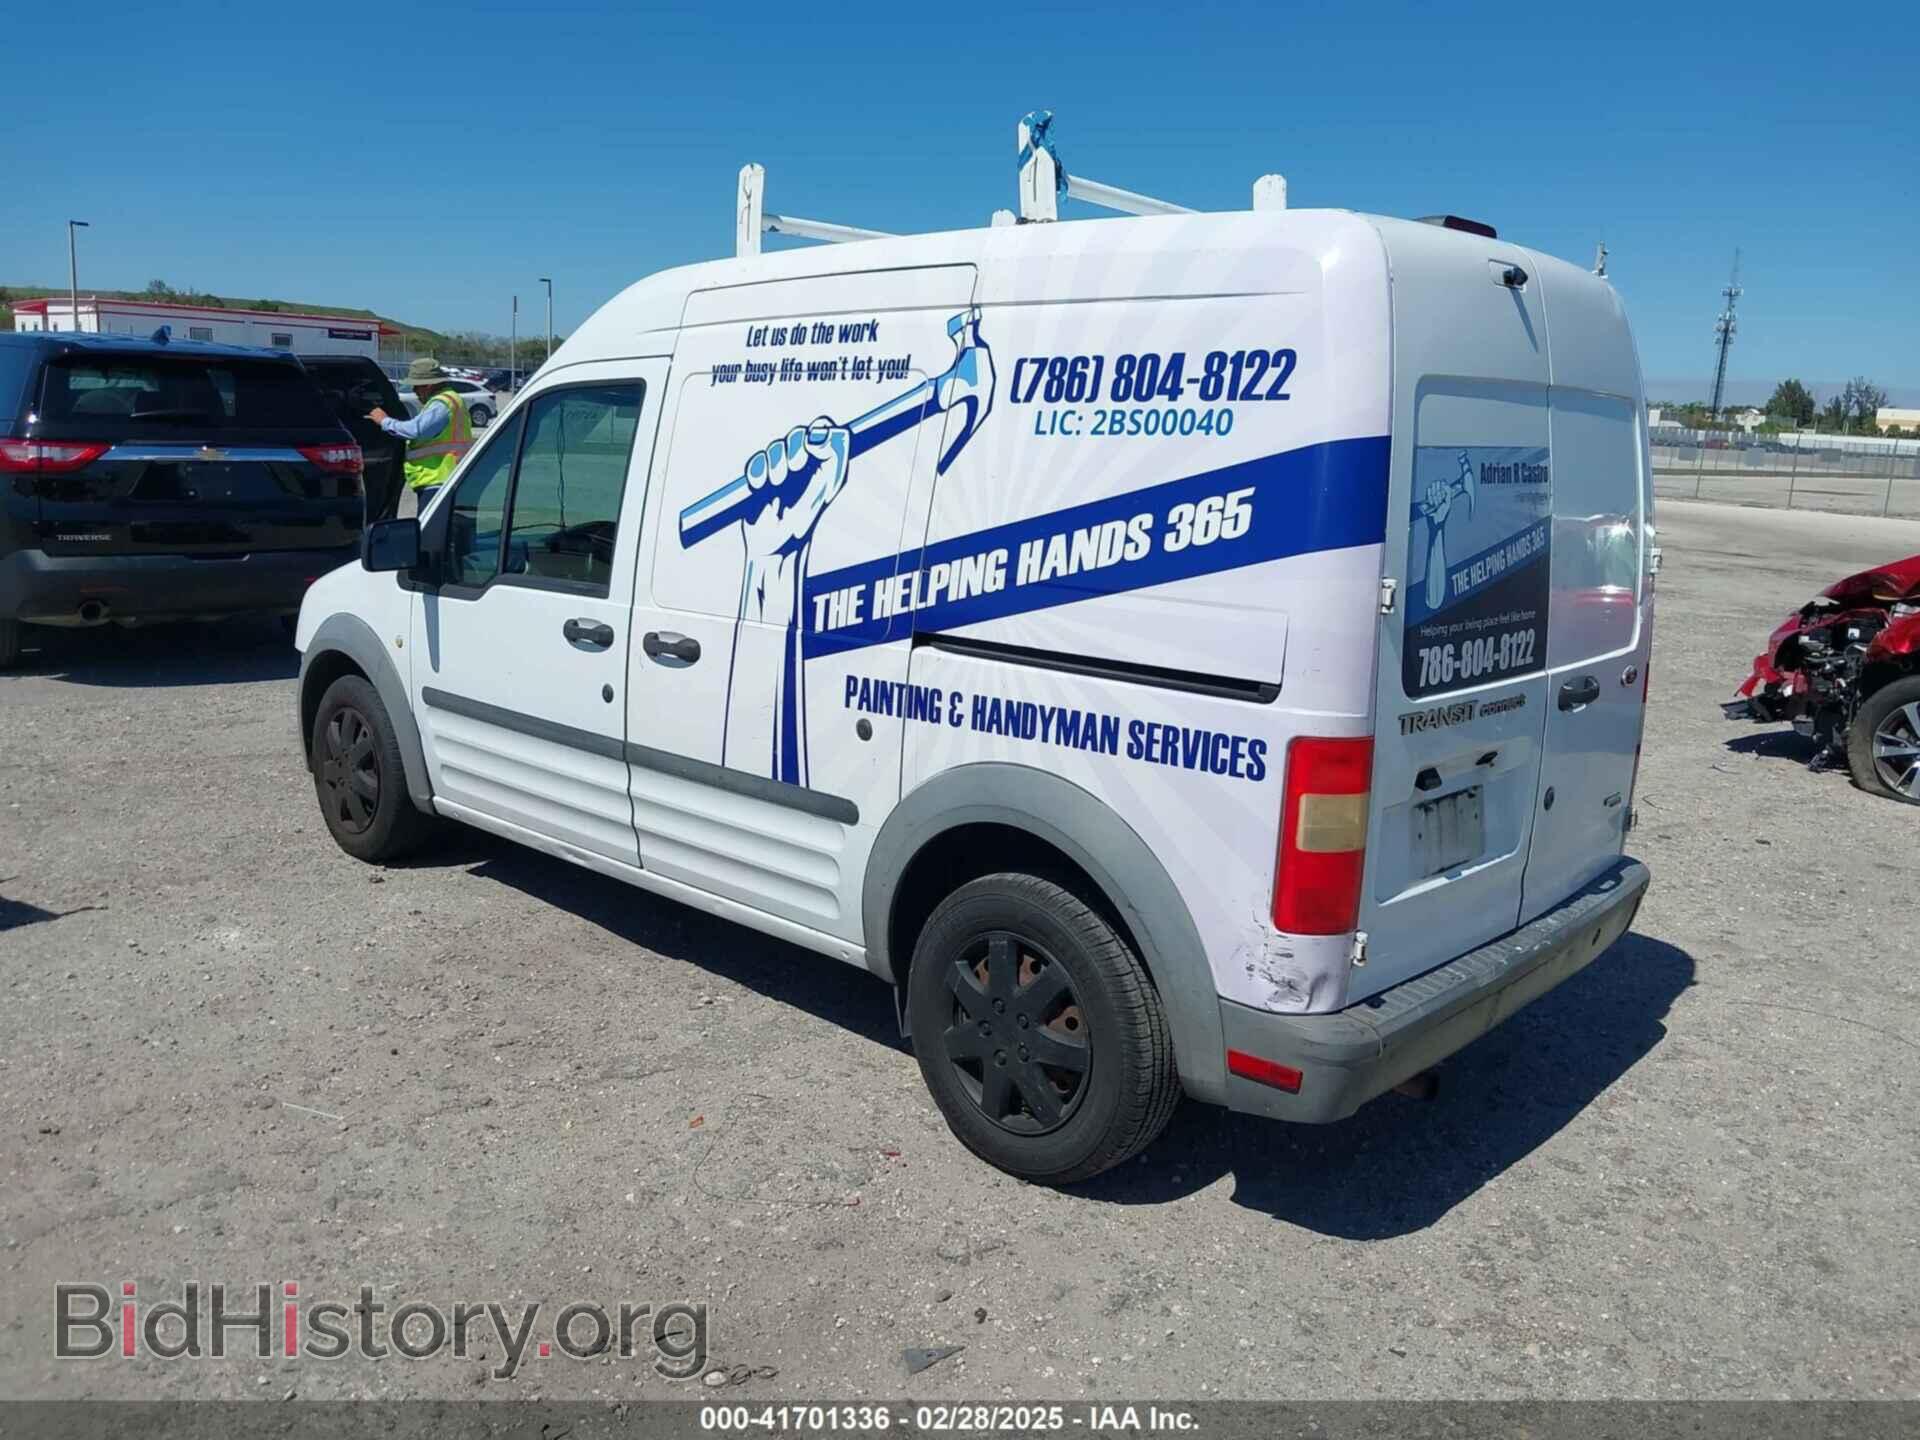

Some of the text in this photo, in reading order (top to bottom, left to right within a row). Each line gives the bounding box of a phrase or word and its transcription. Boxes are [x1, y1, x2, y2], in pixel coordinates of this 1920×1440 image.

[746, 318, 879, 347] Let us do the work
[711, 354, 911, 386] your busy life won't let you!
[1010, 348, 1297, 403] (786) 804-8122
[1034, 407, 1234, 436] LIC: 2BS00040
[1480, 462, 1512, 485] Adrian
[813, 487, 1256, 634] THE HELPING HANDS 365
[1452, 569, 1471, 597] THE
[1470, 549, 1506, 588] HELPING
[1419, 628, 1536, 687] 786-804-8122
[845, 675, 1268, 782] PAINTING & HANDYMAN SERVICES
[1398, 699, 1479, 736] TRANSIT
